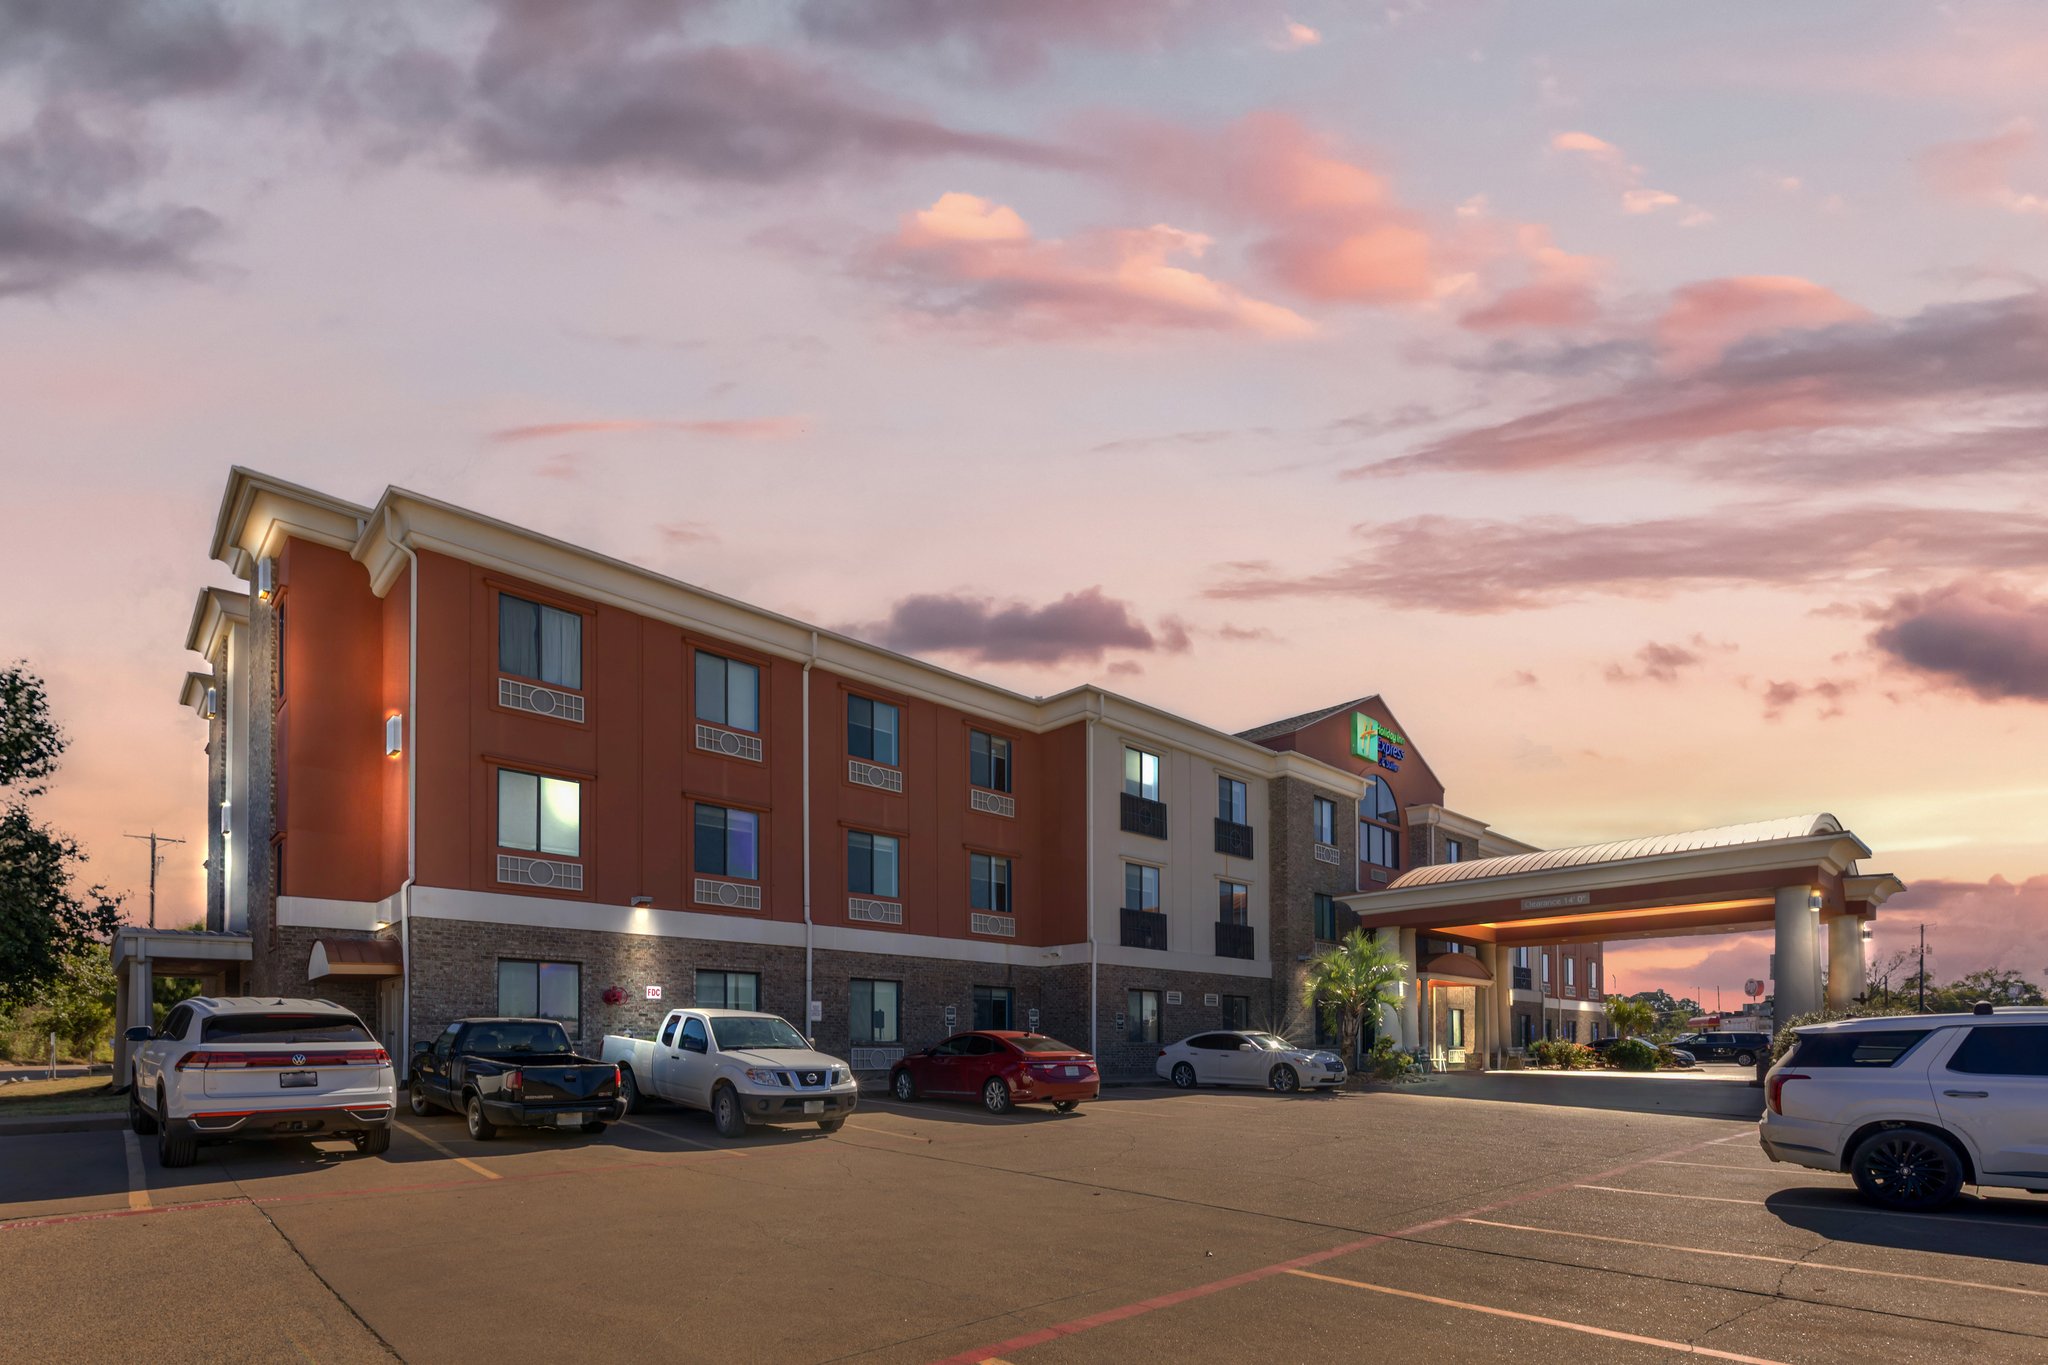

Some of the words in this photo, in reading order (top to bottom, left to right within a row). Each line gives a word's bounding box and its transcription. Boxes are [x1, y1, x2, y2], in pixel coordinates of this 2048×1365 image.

[1378, 737, 1405, 761] Express
[1525, 899, 1561, 909] Clearance
[647, 988, 661, 996] FDC
